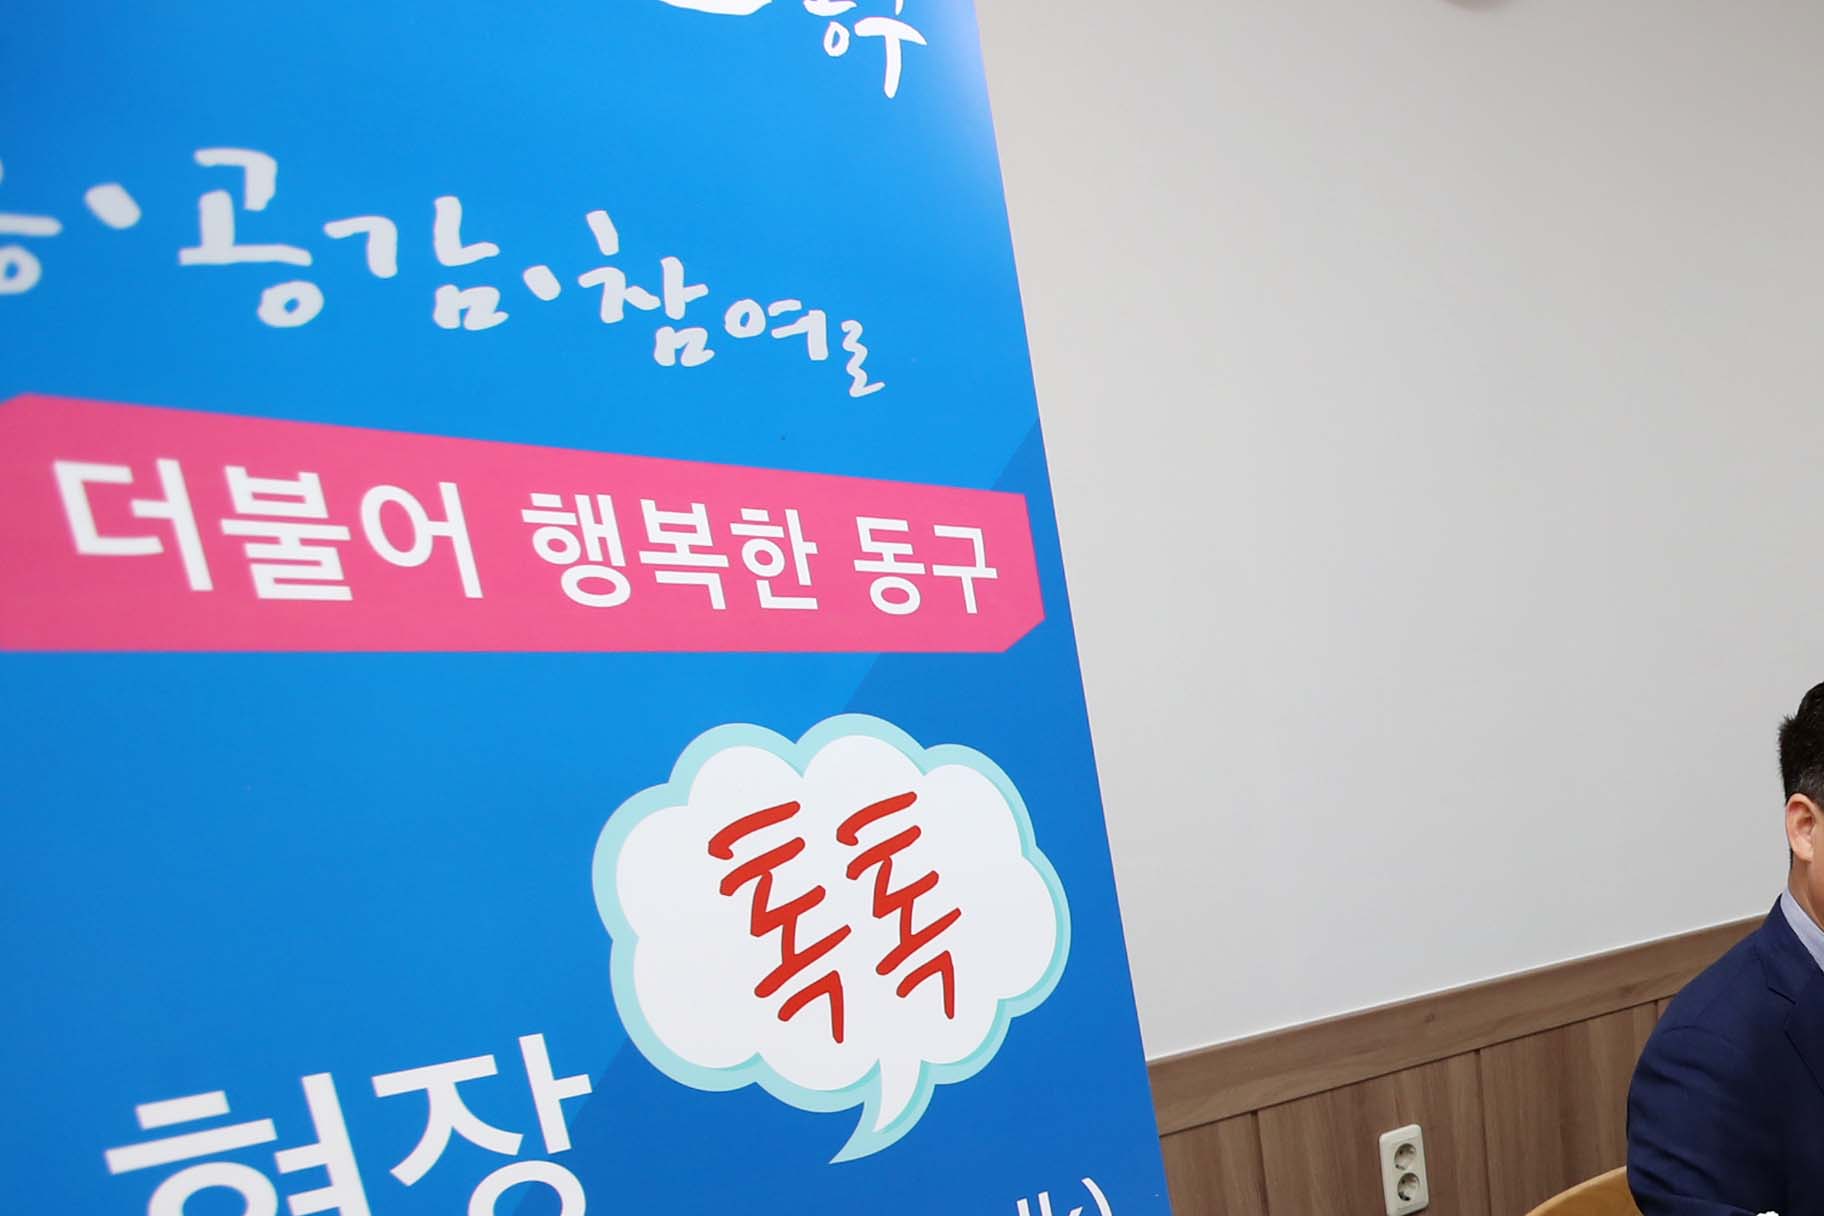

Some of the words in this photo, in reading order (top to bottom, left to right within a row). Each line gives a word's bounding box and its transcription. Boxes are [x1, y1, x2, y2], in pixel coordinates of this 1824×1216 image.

[55, 459, 482, 600] 더불어
[522, 493, 817, 609] 행복한
[854, 517, 997, 614] 동구
[709, 792, 961, 1043] 톡톡
